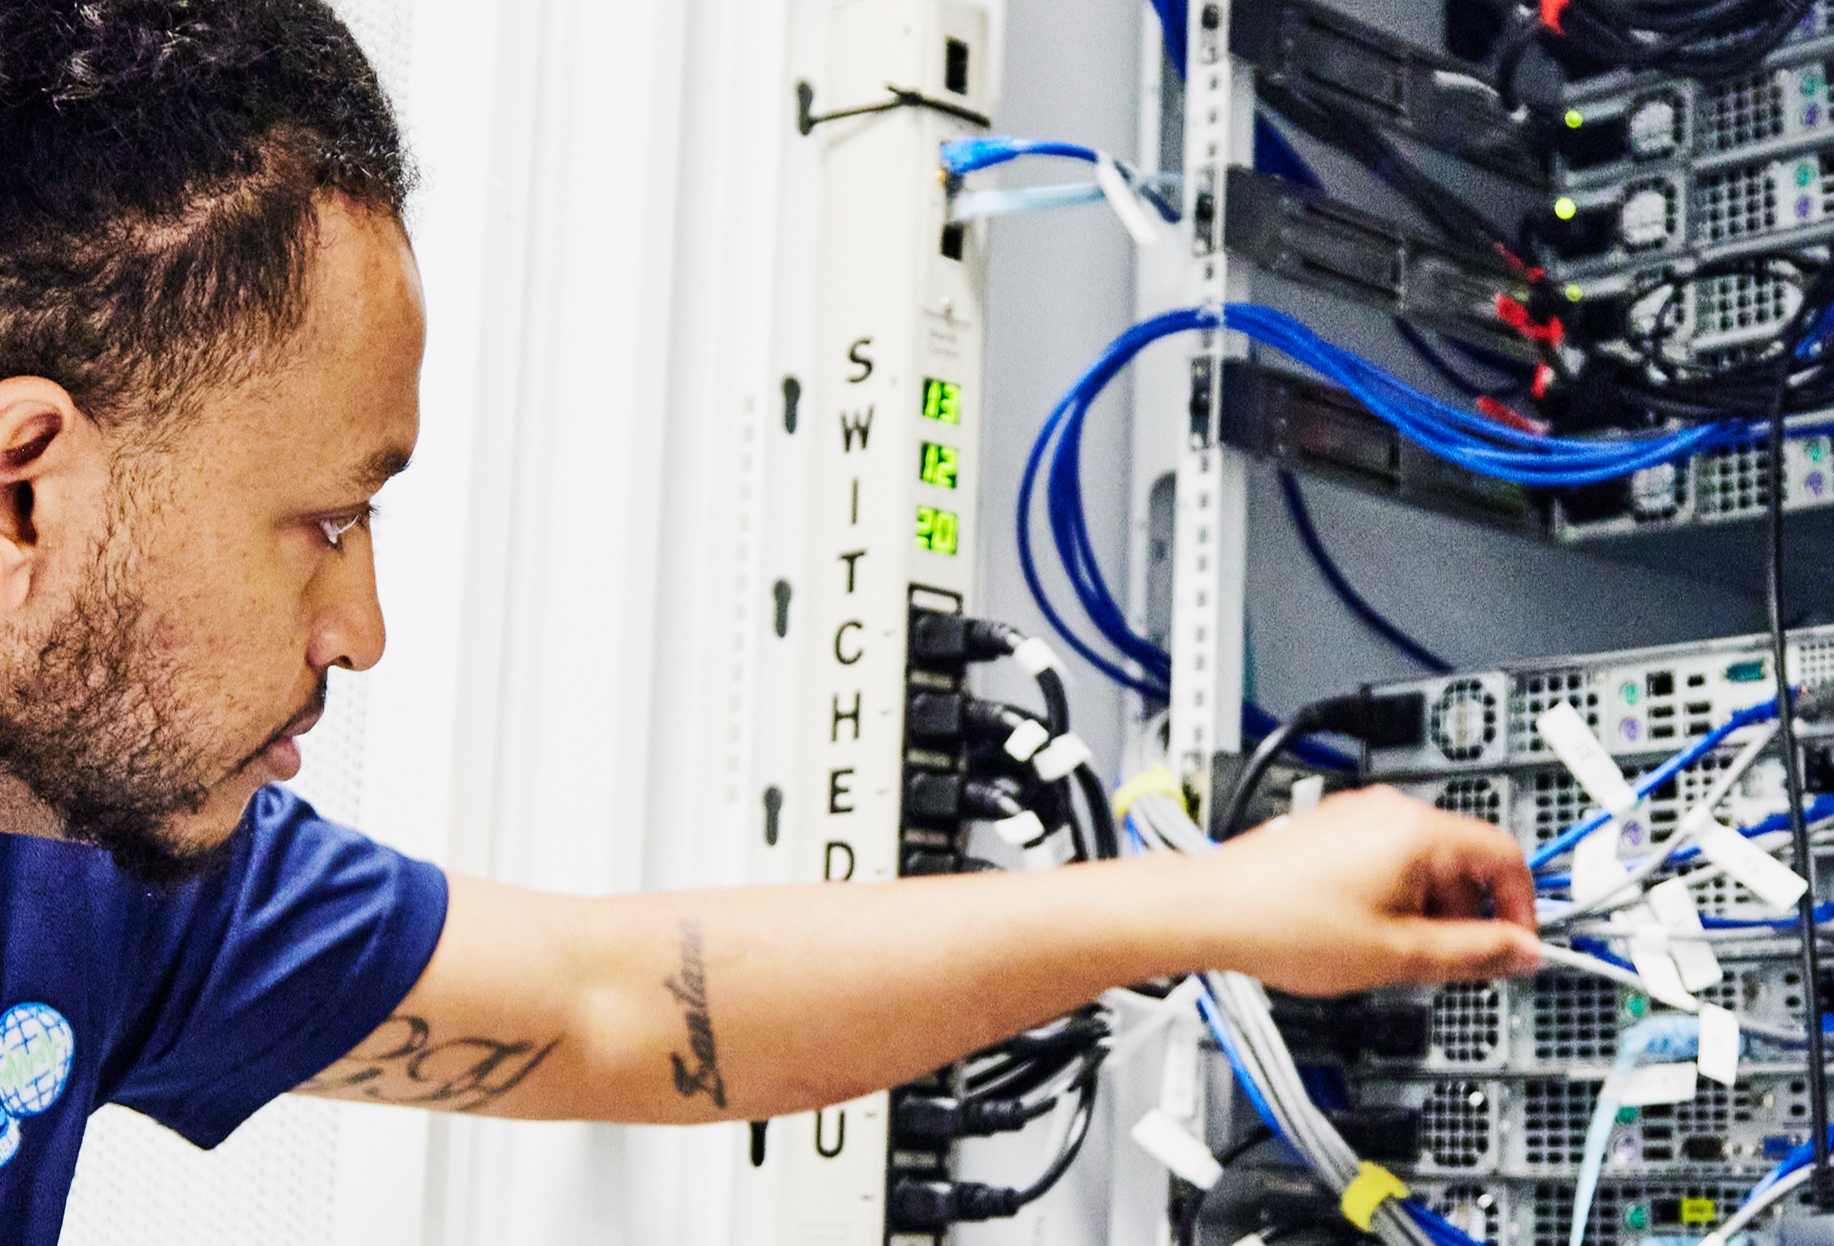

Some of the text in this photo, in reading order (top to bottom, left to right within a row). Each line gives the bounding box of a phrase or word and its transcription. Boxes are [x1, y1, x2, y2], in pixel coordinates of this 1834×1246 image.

[924, 379, 962, 425] 13
[921, 442, 959, 488] 12
[823, 337, 874, 883] SWITCHED
